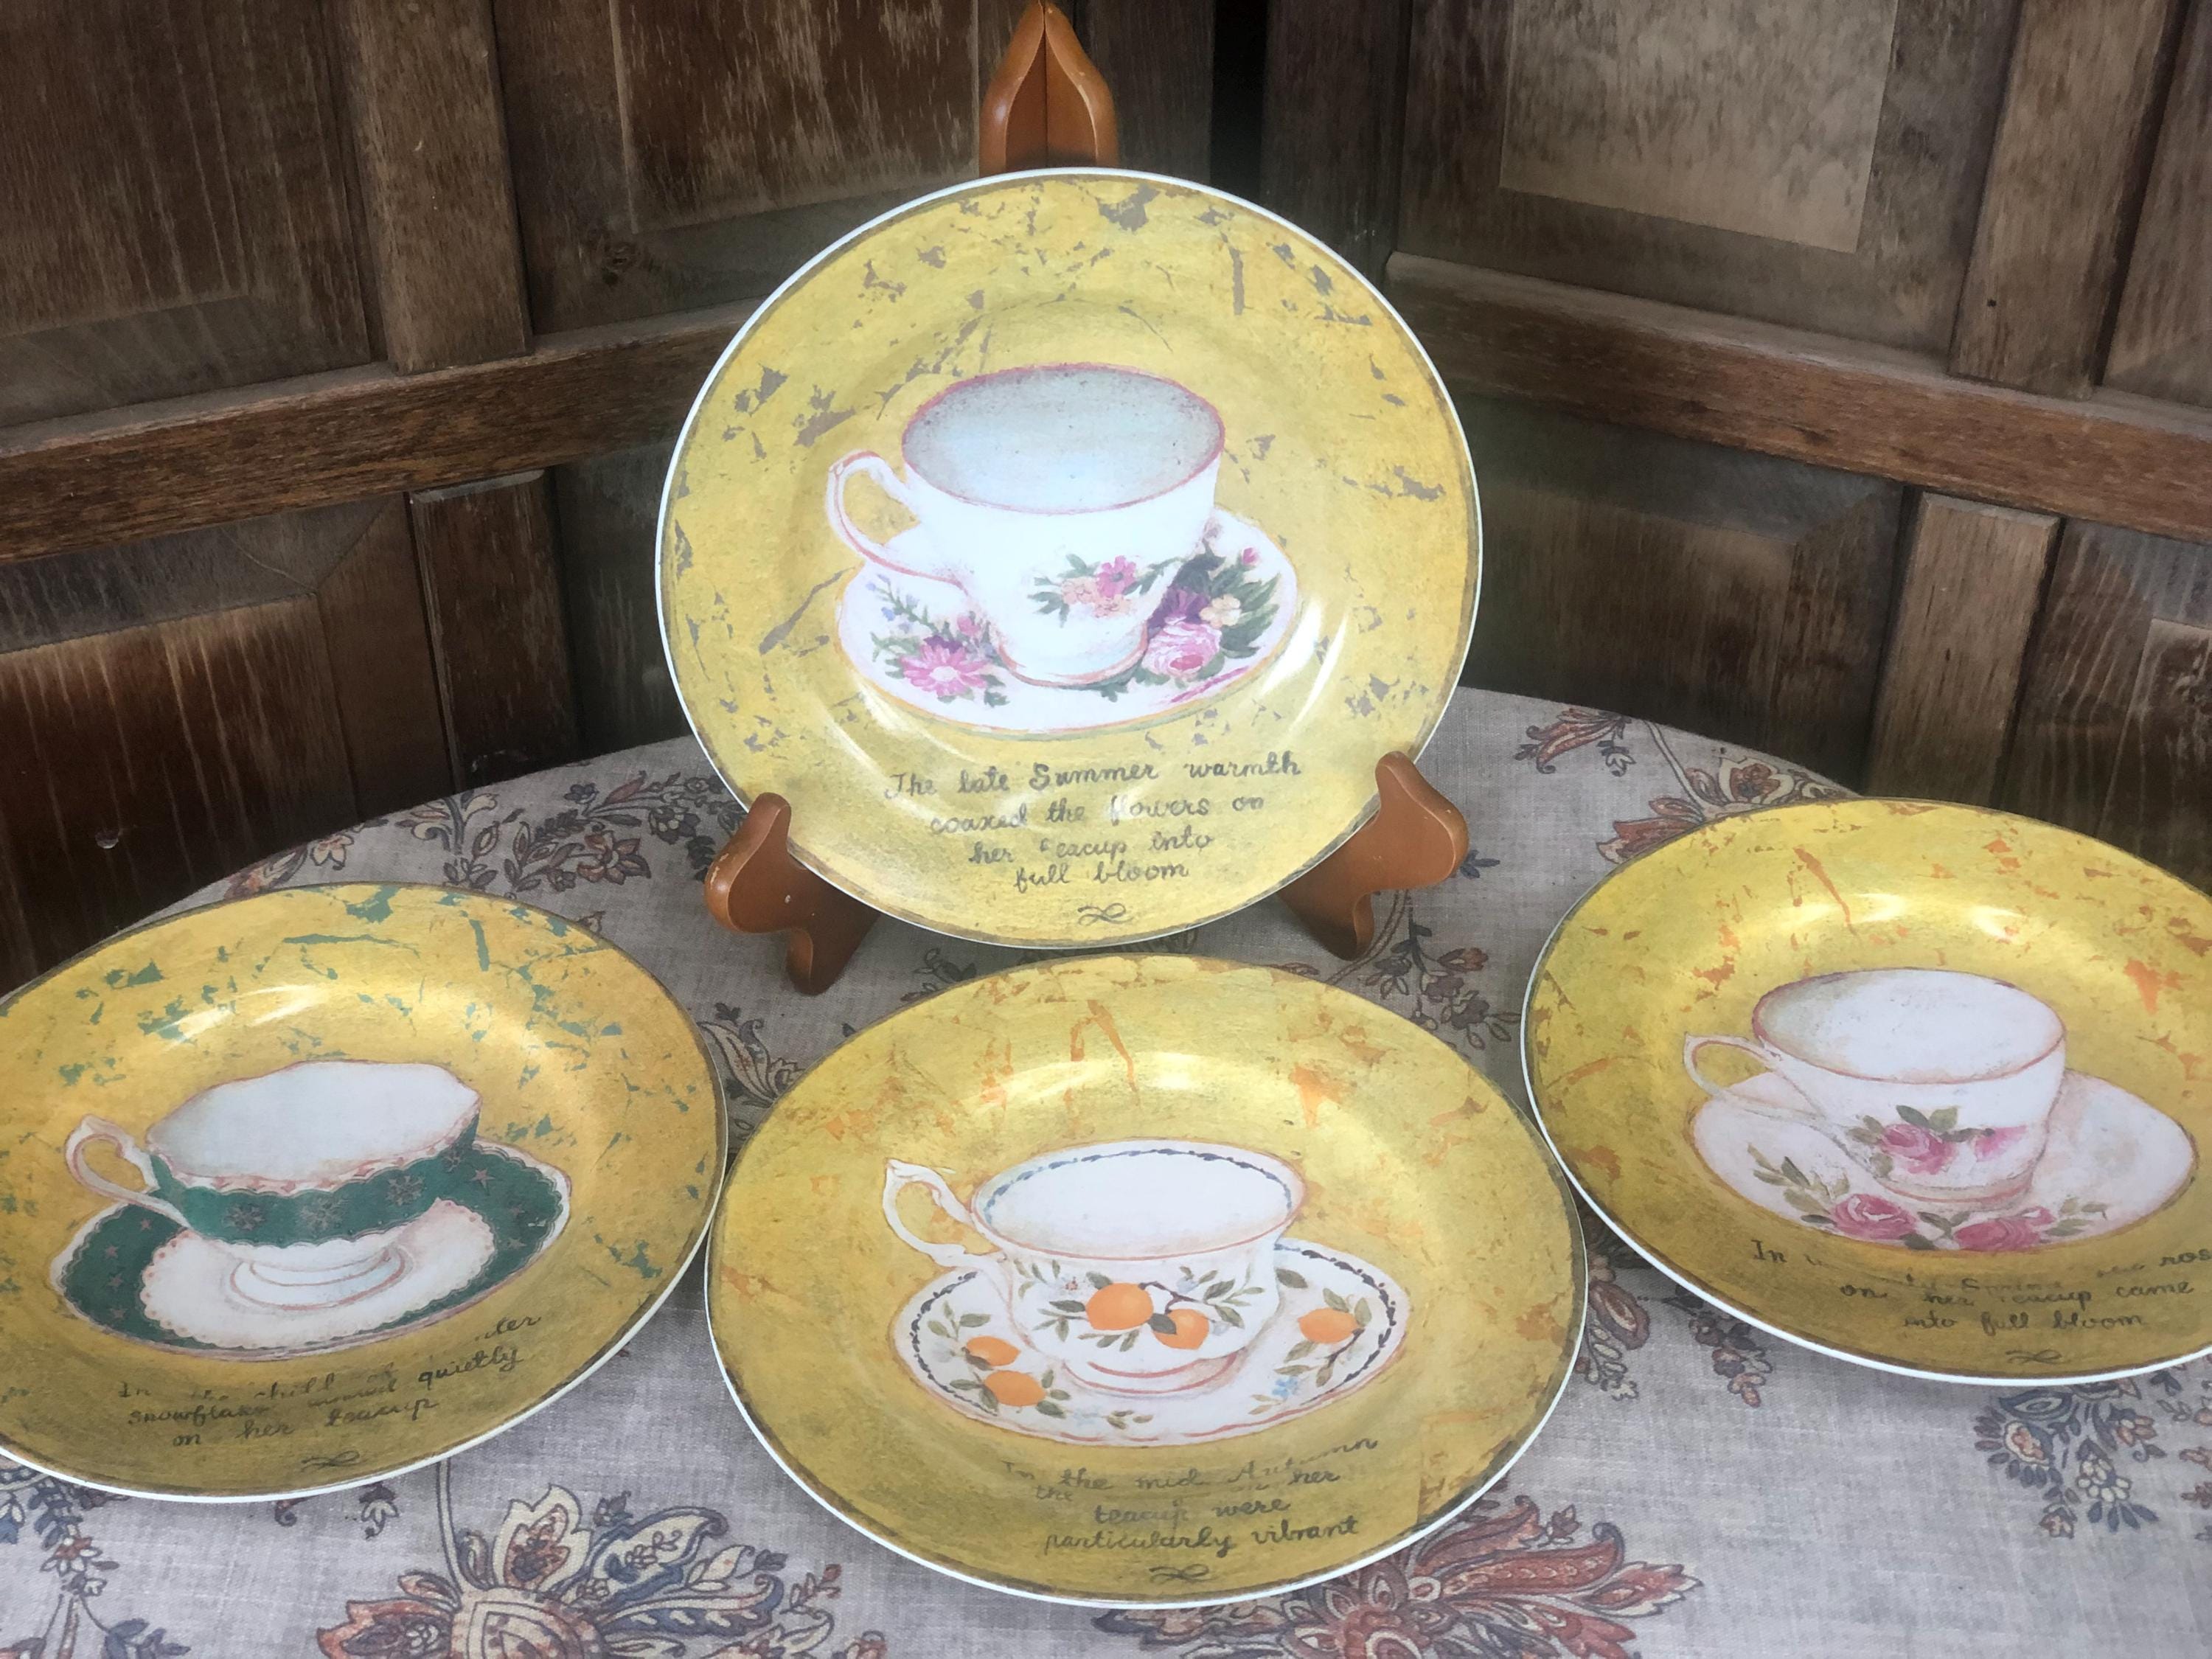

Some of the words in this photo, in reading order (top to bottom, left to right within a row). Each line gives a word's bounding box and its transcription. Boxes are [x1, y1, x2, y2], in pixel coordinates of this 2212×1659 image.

[885, 773, 937, 799] The
[958, 765, 1009, 793] late
[1029, 762, 1159, 791] Summer
[1183, 750, 1302, 779] warmth
[930, 802, 1027, 835] coaxed
[1045, 797, 1085, 823] the
[1231, 795, 1265, 813] on
[967, 841, 1015, 864] her
[1150, 824, 1214, 852] into
[1014, 863, 1071, 894] full
[1093, 859, 1189, 884] bloom
[1750, 1239, 1787, 1262] In
[1840, 1284, 1888, 1299] on
[2000, 1290, 2093, 1311] eacup
[2115, 1281, 2195, 1297] came
[1904, 1310, 1958, 1328] into
[1980, 1311, 2029, 1337] full
[2054, 1310, 2148, 1329] bloom
[417, 1345, 525, 1391] quietly
[172, 1433, 201, 1447] on
[234, 1419, 295, 1439] her
[1058, 1467, 1115, 1490] the
[1211, 1498, 1292, 1517] were
[1043, 1526, 1237, 1558] particularly
[1251, 1514, 1360, 1545] vibrant
